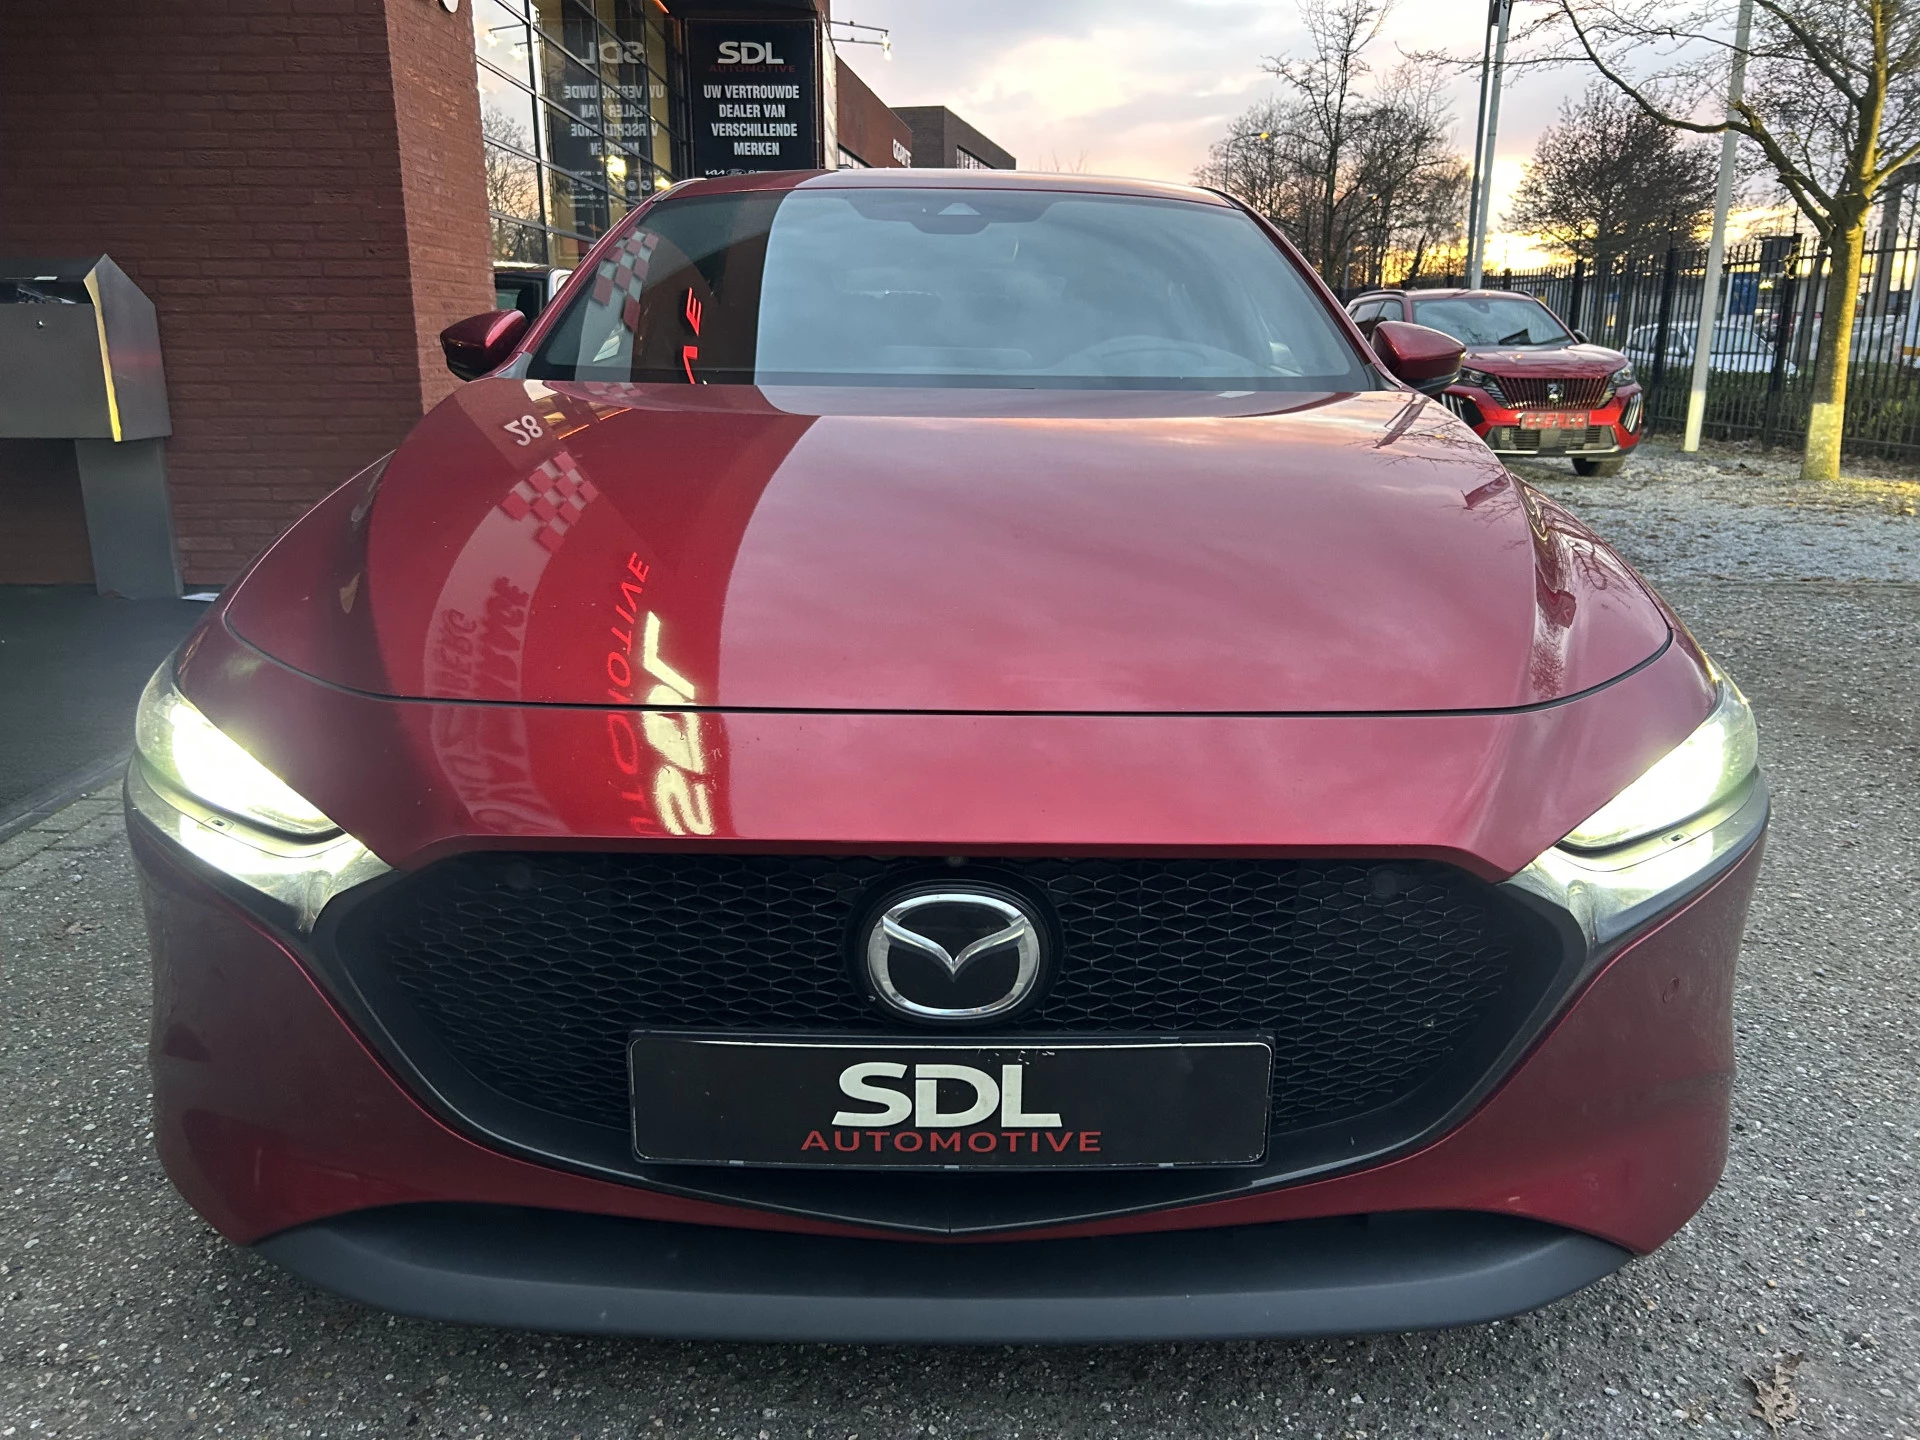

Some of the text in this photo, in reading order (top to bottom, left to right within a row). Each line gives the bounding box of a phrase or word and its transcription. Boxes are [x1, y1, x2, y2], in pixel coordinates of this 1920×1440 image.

[718, 42, 784, 64] SDL
[709, 65, 795, 73] AUTOMOTIVE
[704, 85, 799, 98] UW VERTROUWDE
[719, 104, 785, 117] DEALER VAN
[711, 123, 797, 136] VERSCHILLENDE
[734, 142, 779, 155] MERKEN
[832, 1062, 1062, 1128] SDL
[801, 1131, 1102, 1153] AUTOMOTIVE
